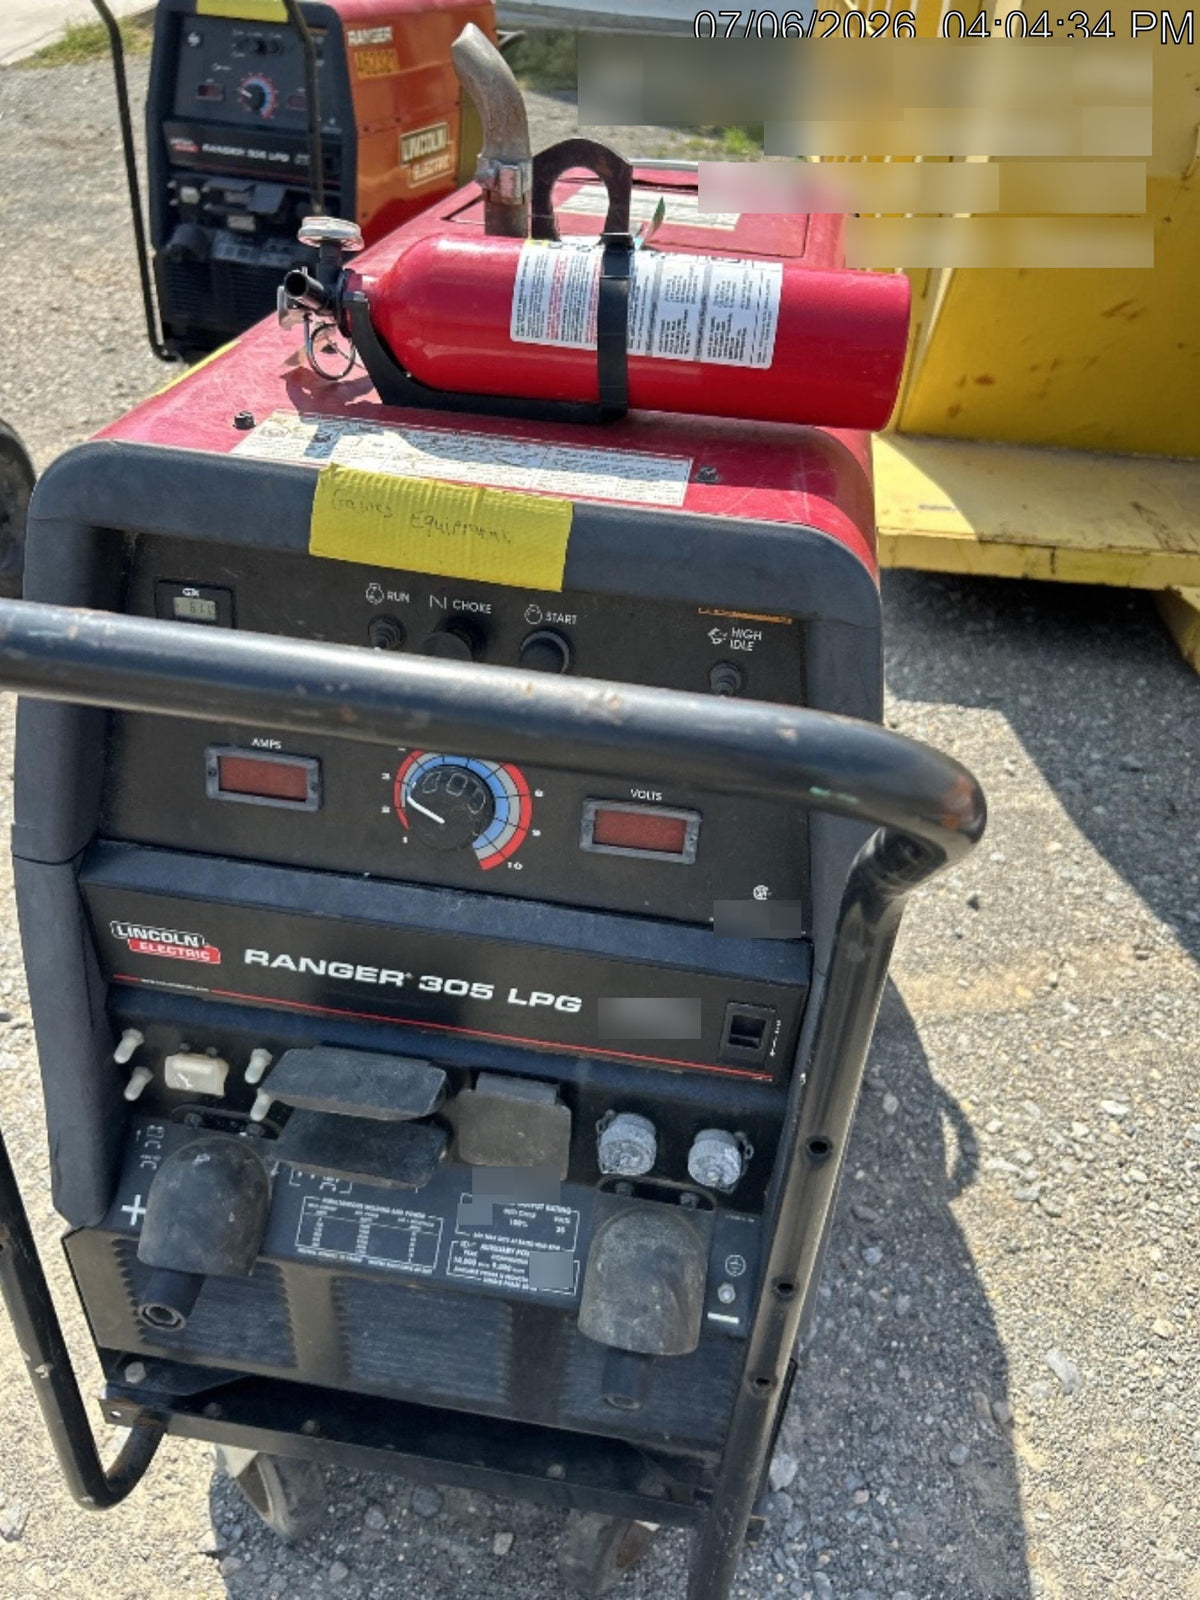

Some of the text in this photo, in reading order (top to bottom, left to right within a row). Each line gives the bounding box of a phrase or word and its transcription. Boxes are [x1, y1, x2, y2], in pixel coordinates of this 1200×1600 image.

[387, 591, 410, 603] RUN
[453, 599, 492, 614] CHOKE
[546, 611, 578, 625] START
[731, 627, 763, 641] HIGH
[730, 639, 755, 652] IDLE
[251, 738, 282, 749] AMPS
[630, 788, 663, 801] VOLTS
[507, 861, 524, 871] 10
[116, 924, 200, 948] LINCOLN
[138, 940, 212, 962] ELECTRIC
[418, 974, 495, 1000] 305
[506, 987, 583, 1013] LPG
